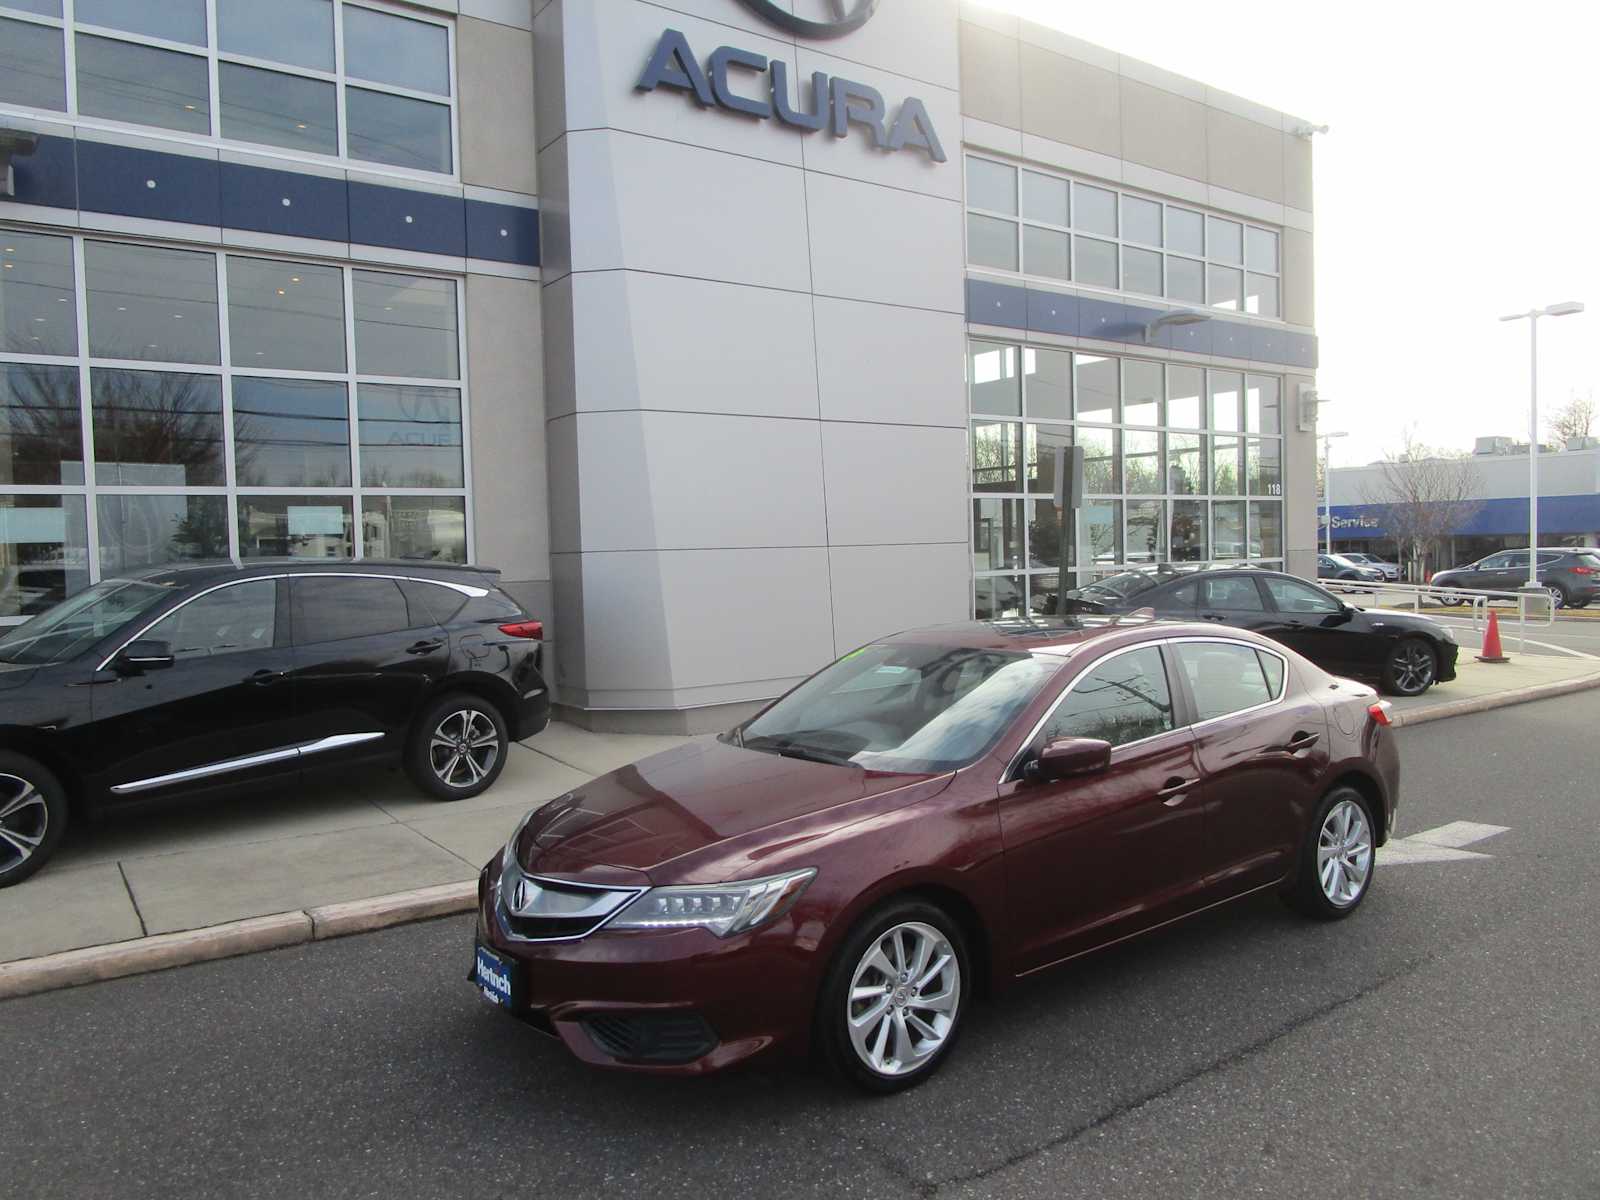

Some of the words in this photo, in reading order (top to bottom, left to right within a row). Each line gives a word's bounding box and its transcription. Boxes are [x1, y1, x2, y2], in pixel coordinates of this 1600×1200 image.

[634, 28, 947, 162] ACURA
[1266, 483, 1280, 494] 118
[1331, 515, 1379, 528] Service
